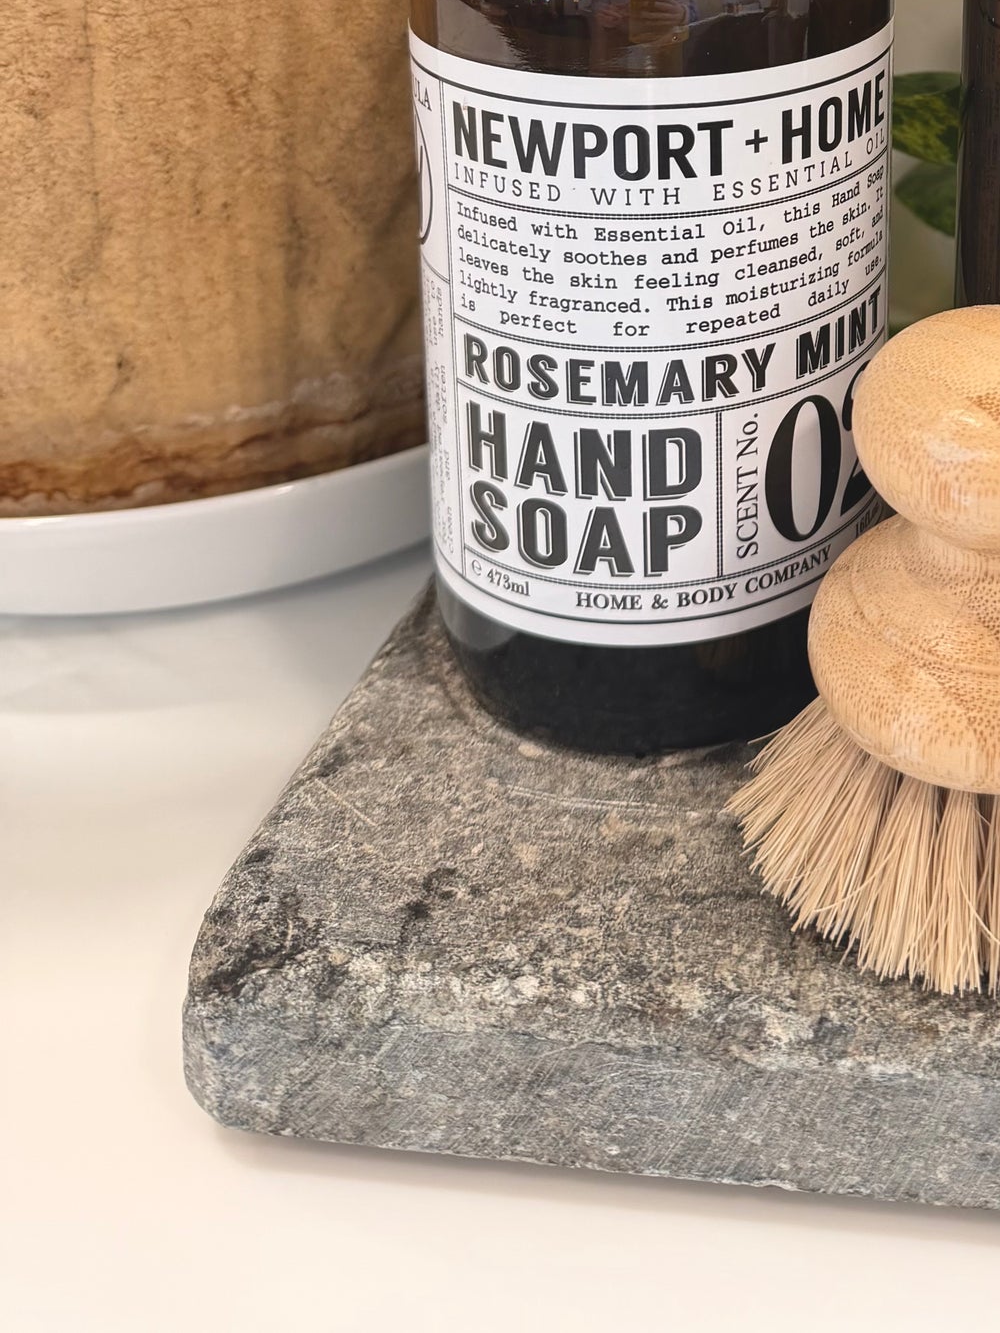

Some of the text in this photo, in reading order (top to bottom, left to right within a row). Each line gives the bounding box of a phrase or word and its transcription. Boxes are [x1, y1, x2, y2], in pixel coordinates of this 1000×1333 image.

[452, 69, 886, 182] NEWPORT + HOME
[454, 128, 885, 206] INFUSED WITH ESSENTIAL OIL
[457, 165, 884, 242] Infused with Essential Oil, this Hand Soap
[457, 186, 884, 266] delicately soothes and perfumes the skin. It
[459, 205, 884, 290] leaves the skin feeling cleansed, soft, and
[459, 228, 883, 314] lightly fragranced. This moisturizing formula
[461, 258, 882, 337] is perfect for repeated daily use.
[463, 285, 882, 407] ROSEMARY MINT
[466, 400, 702, 501] HAND
[736, 413, 758, 559] SCENT No.
[470, 479, 702, 578] SOAP
[487, 568, 530, 597] 473ml
[575, 545, 832, 610] HOME & BODY COMPANY
